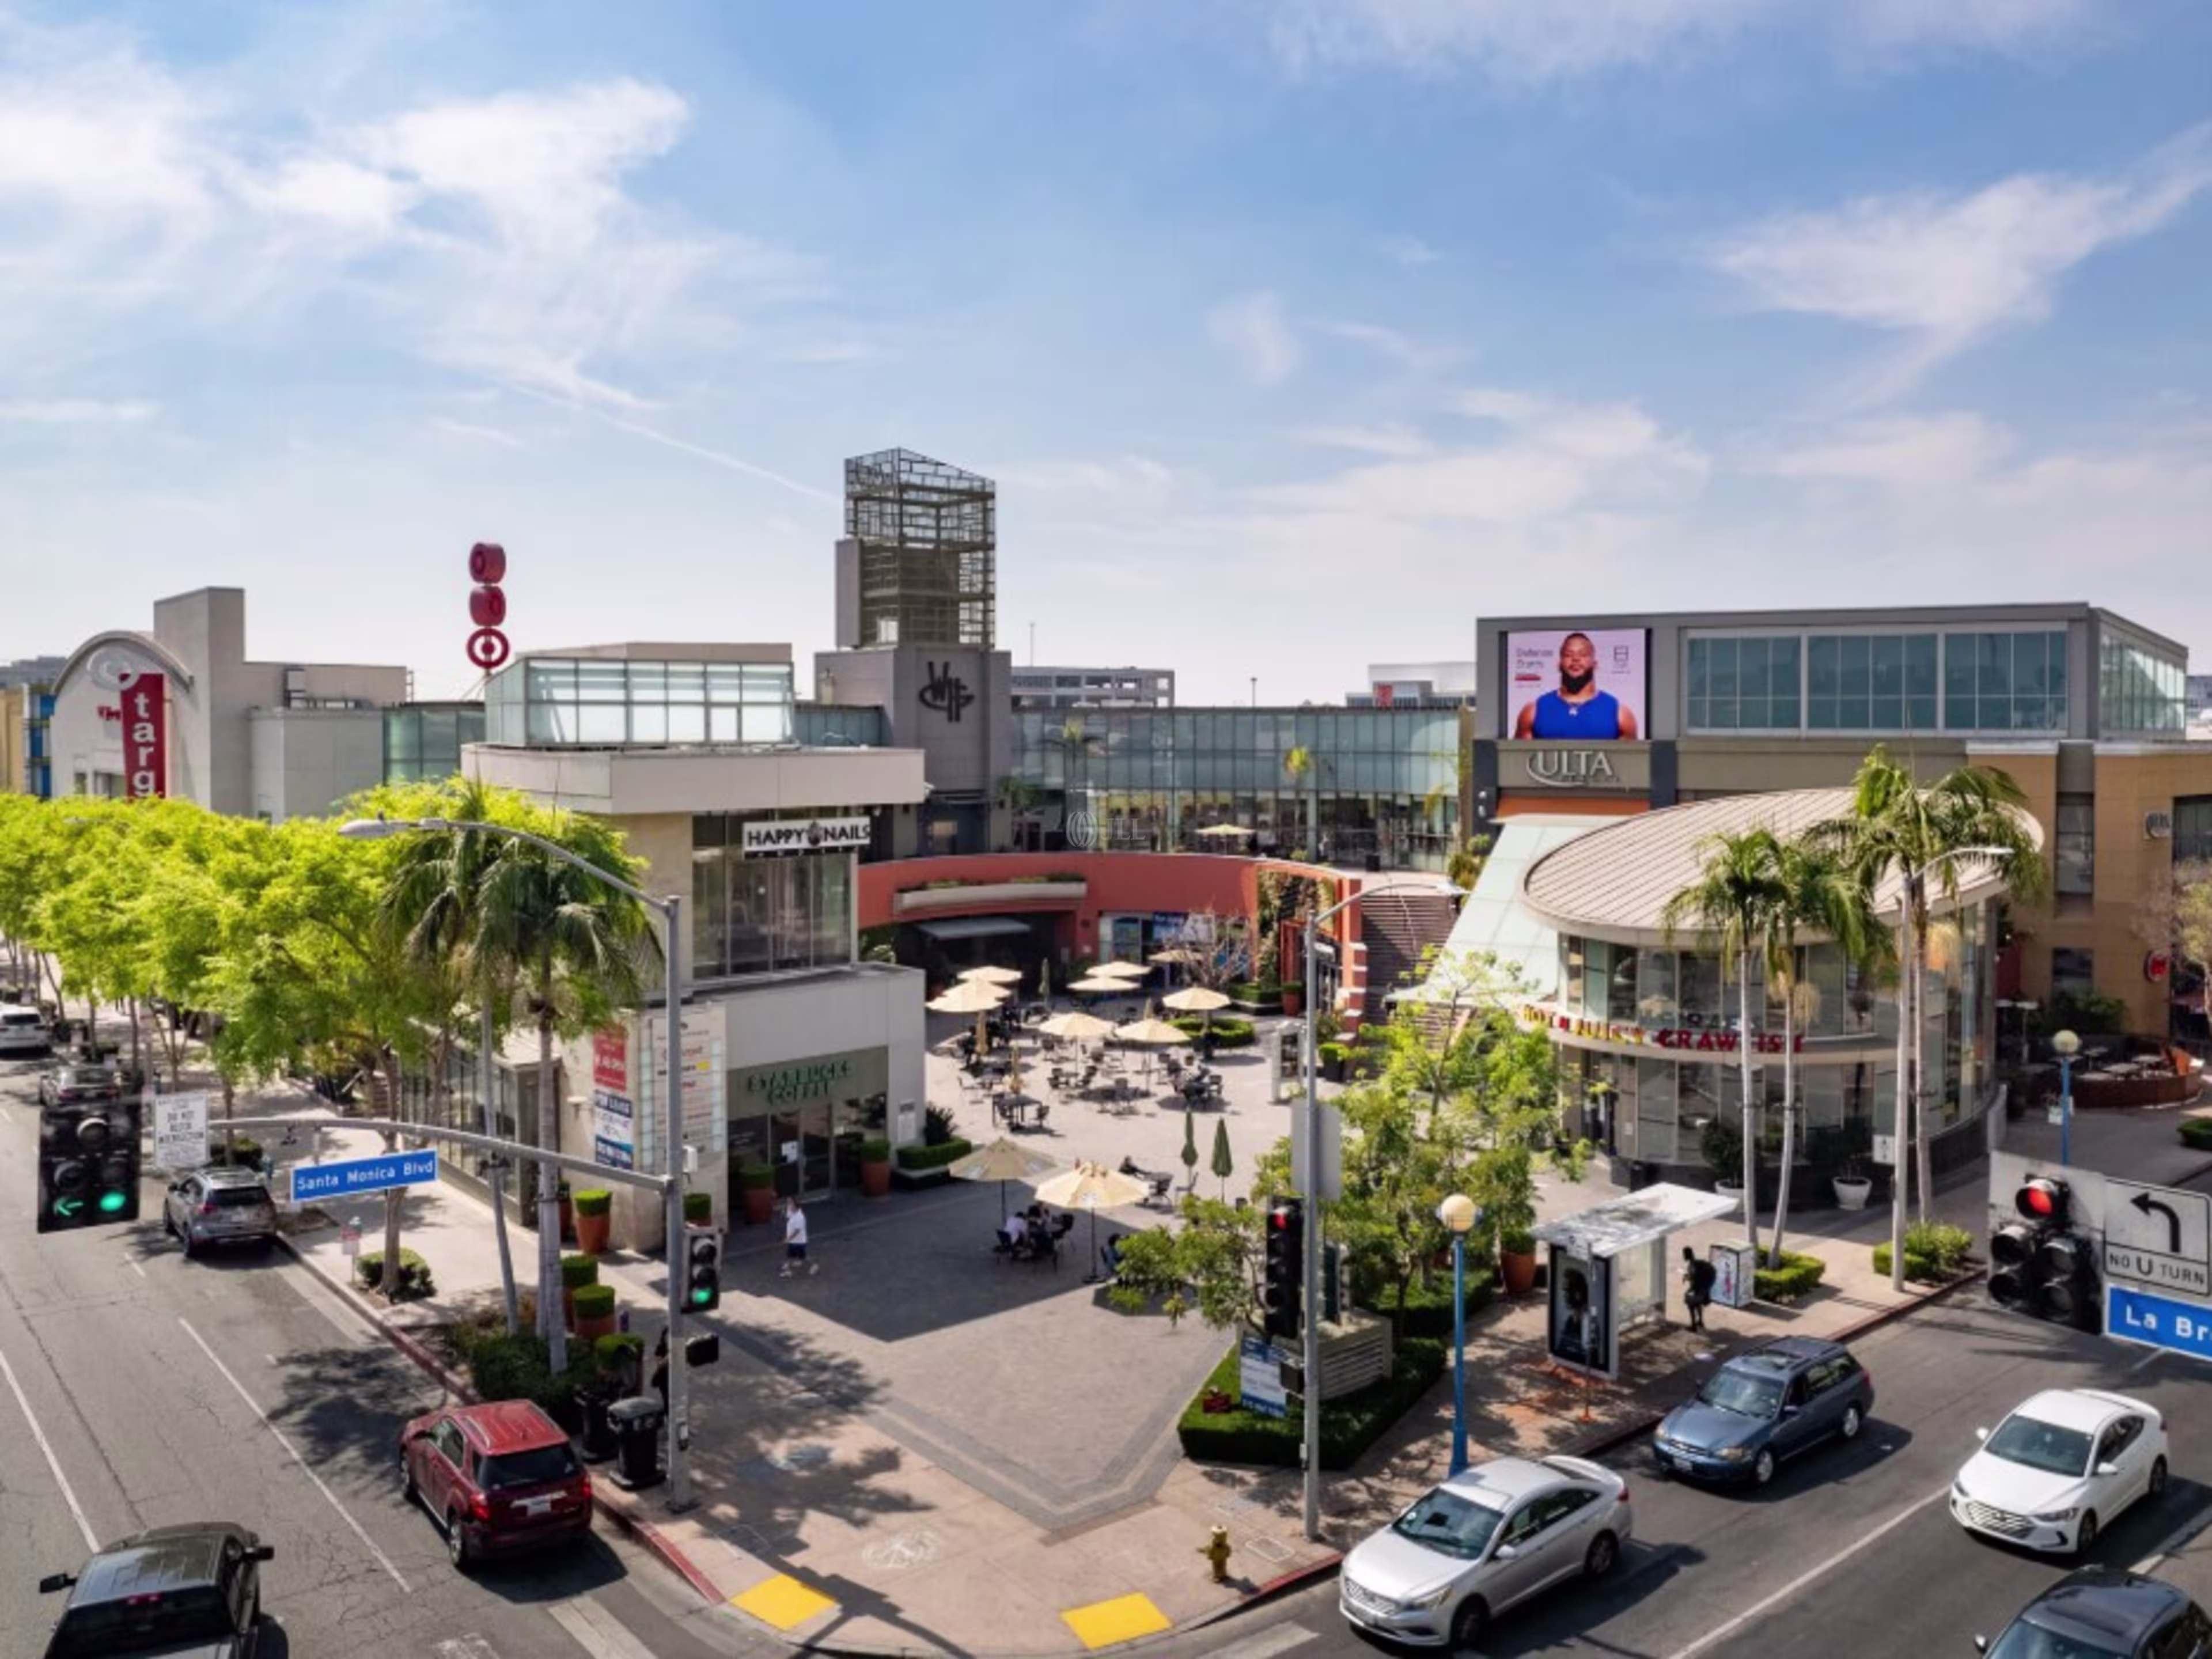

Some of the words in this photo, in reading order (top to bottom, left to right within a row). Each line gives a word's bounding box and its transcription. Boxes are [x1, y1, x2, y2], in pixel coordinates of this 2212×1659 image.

[1537, 750, 1612, 776] ULTA
[748, 828, 806, 846] HAPPY
[824, 824, 870, 842] NAILS
[1574, 1018, 1646, 1044] JUICY
[297, 1174, 339, 1191] Santa
[347, 1168, 396, 1184] Monica
[403, 1160, 434, 1176] Blvd
[2109, 1252, 2131, 1268] NO
[2137, 1256, 2154, 1276] U
[2160, 1263, 2205, 1285] TURN
[2126, 1304, 2157, 1330] La
[2176, 1316, 2212, 1341] Br
